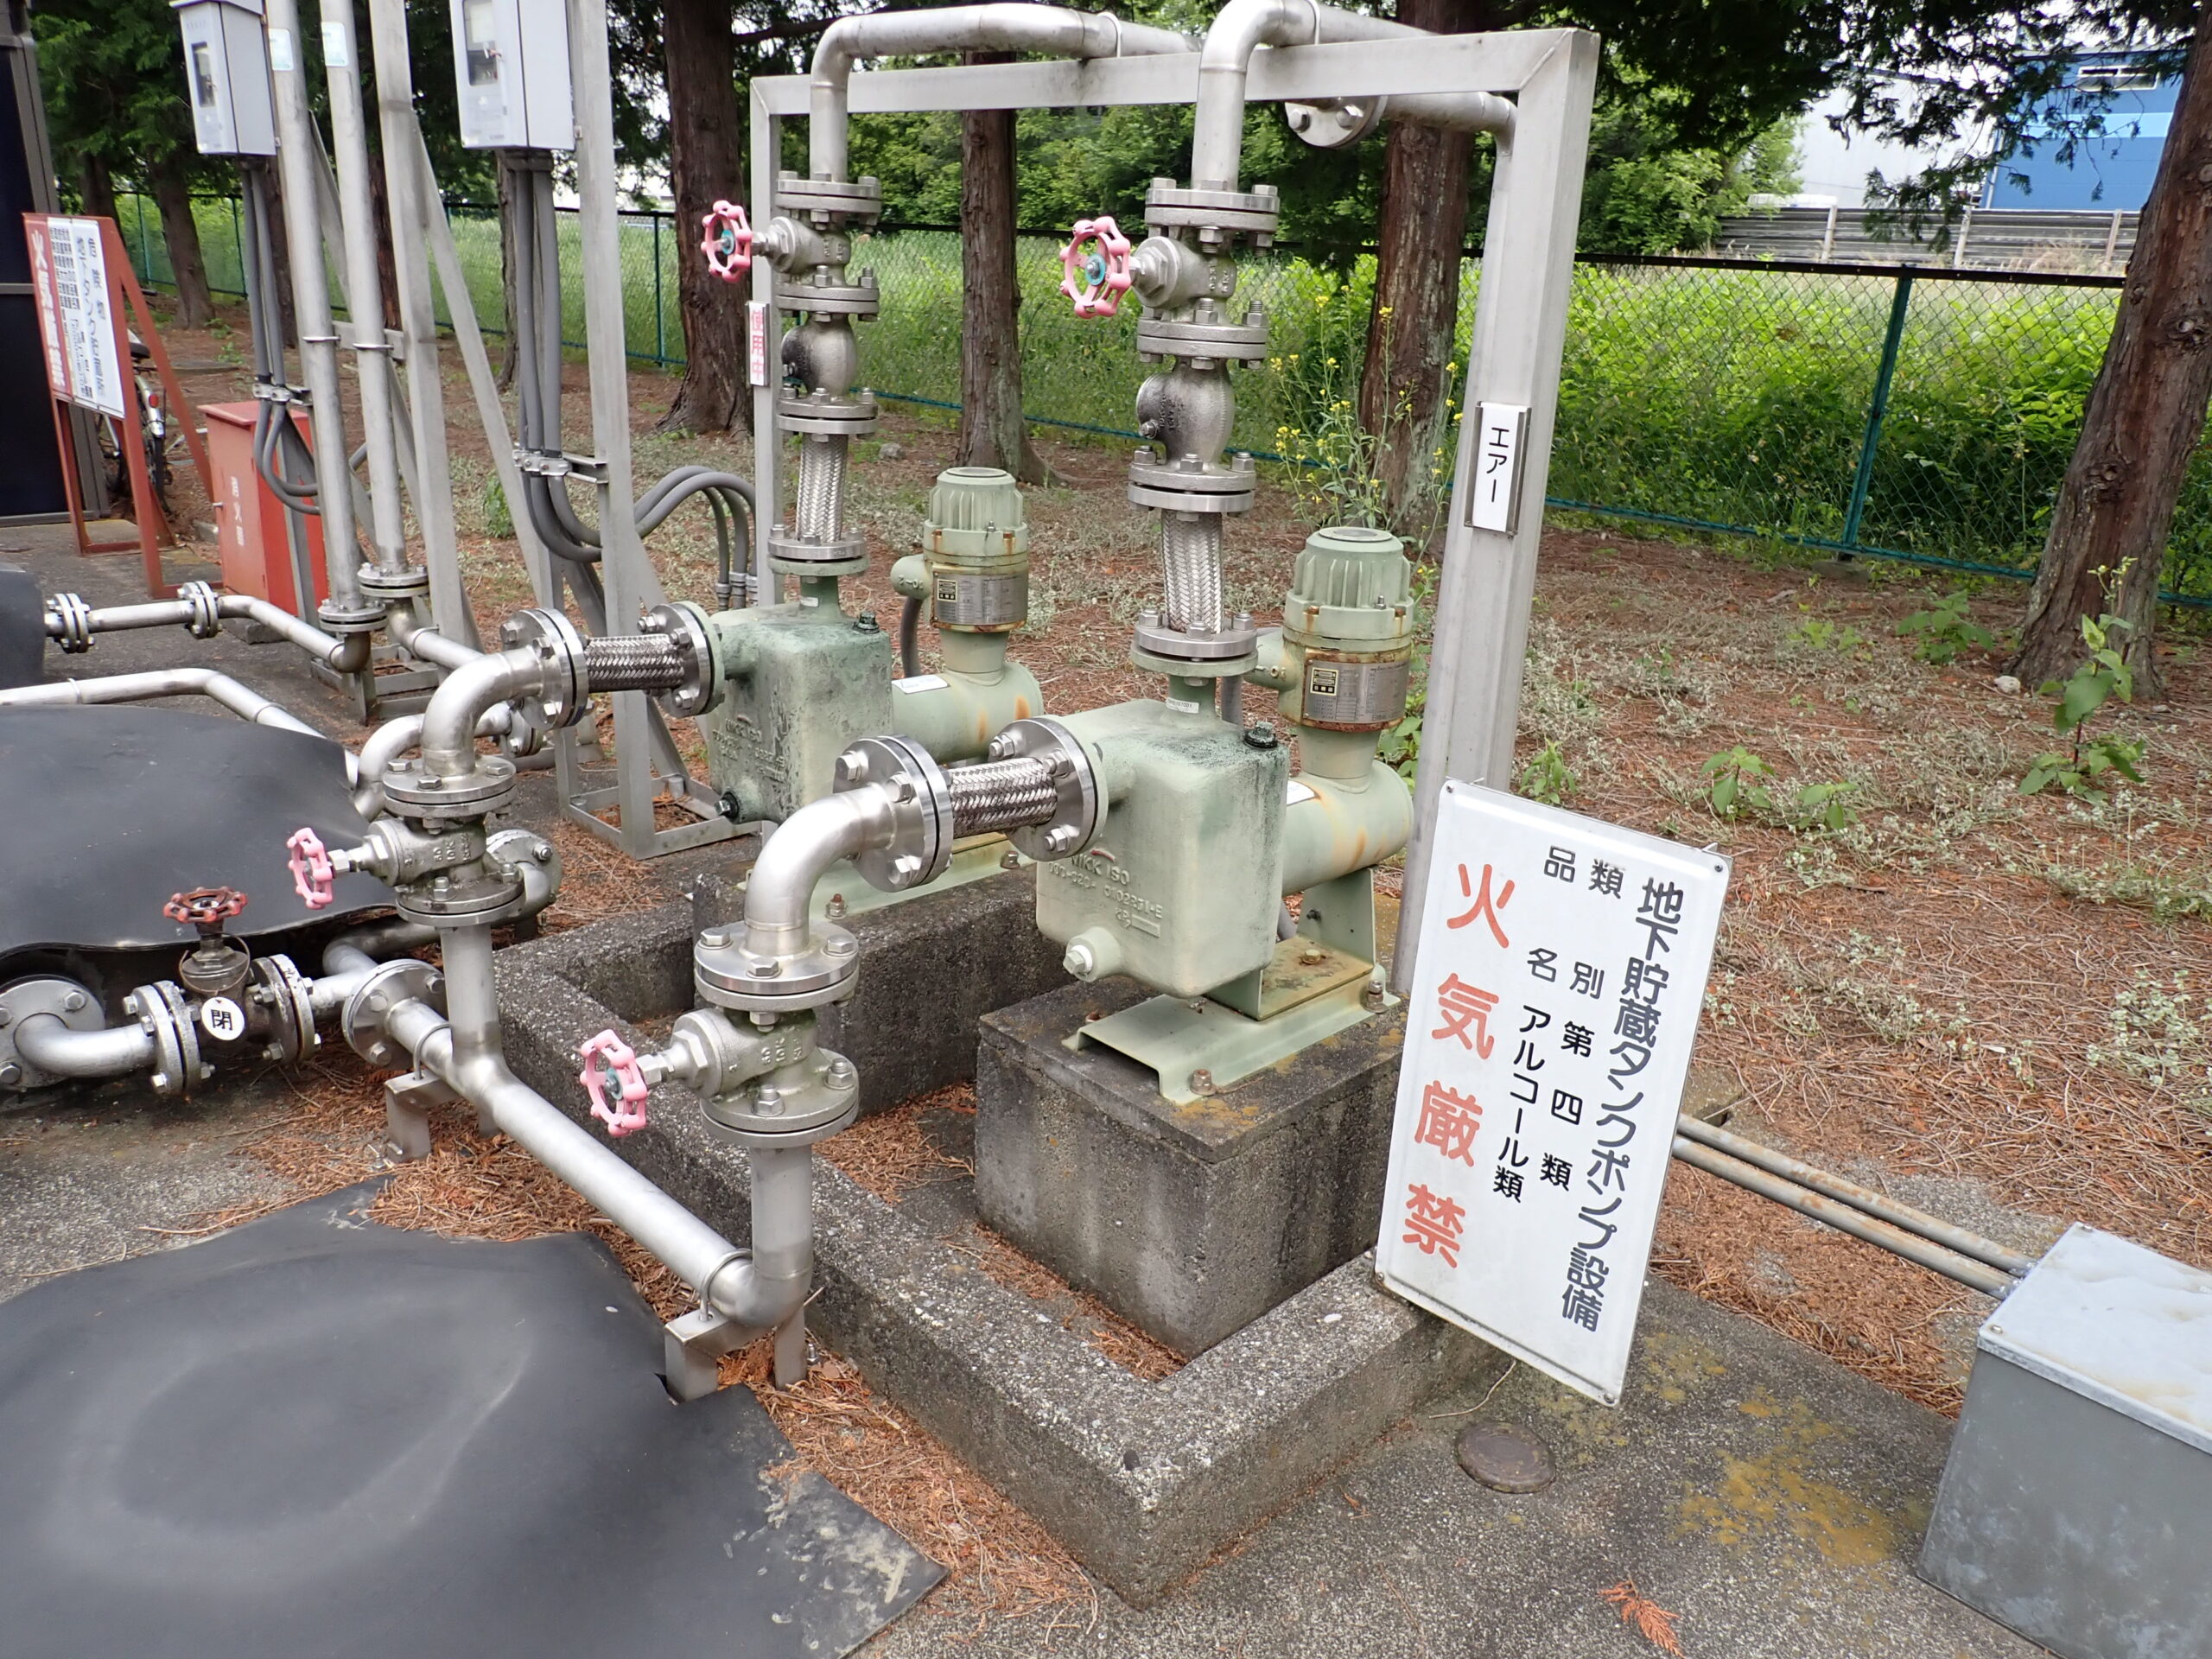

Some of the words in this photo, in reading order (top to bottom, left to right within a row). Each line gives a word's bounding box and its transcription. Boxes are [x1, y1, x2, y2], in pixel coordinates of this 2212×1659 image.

[1485, 426, 1510, 504] エアー
[211, 1009, 232, 1030] 閉
[1403, 864, 1515, 1267] 火気厳禁
[1562, 879, 1683, 1332] 地下貯蔵タンクポンプ設備
